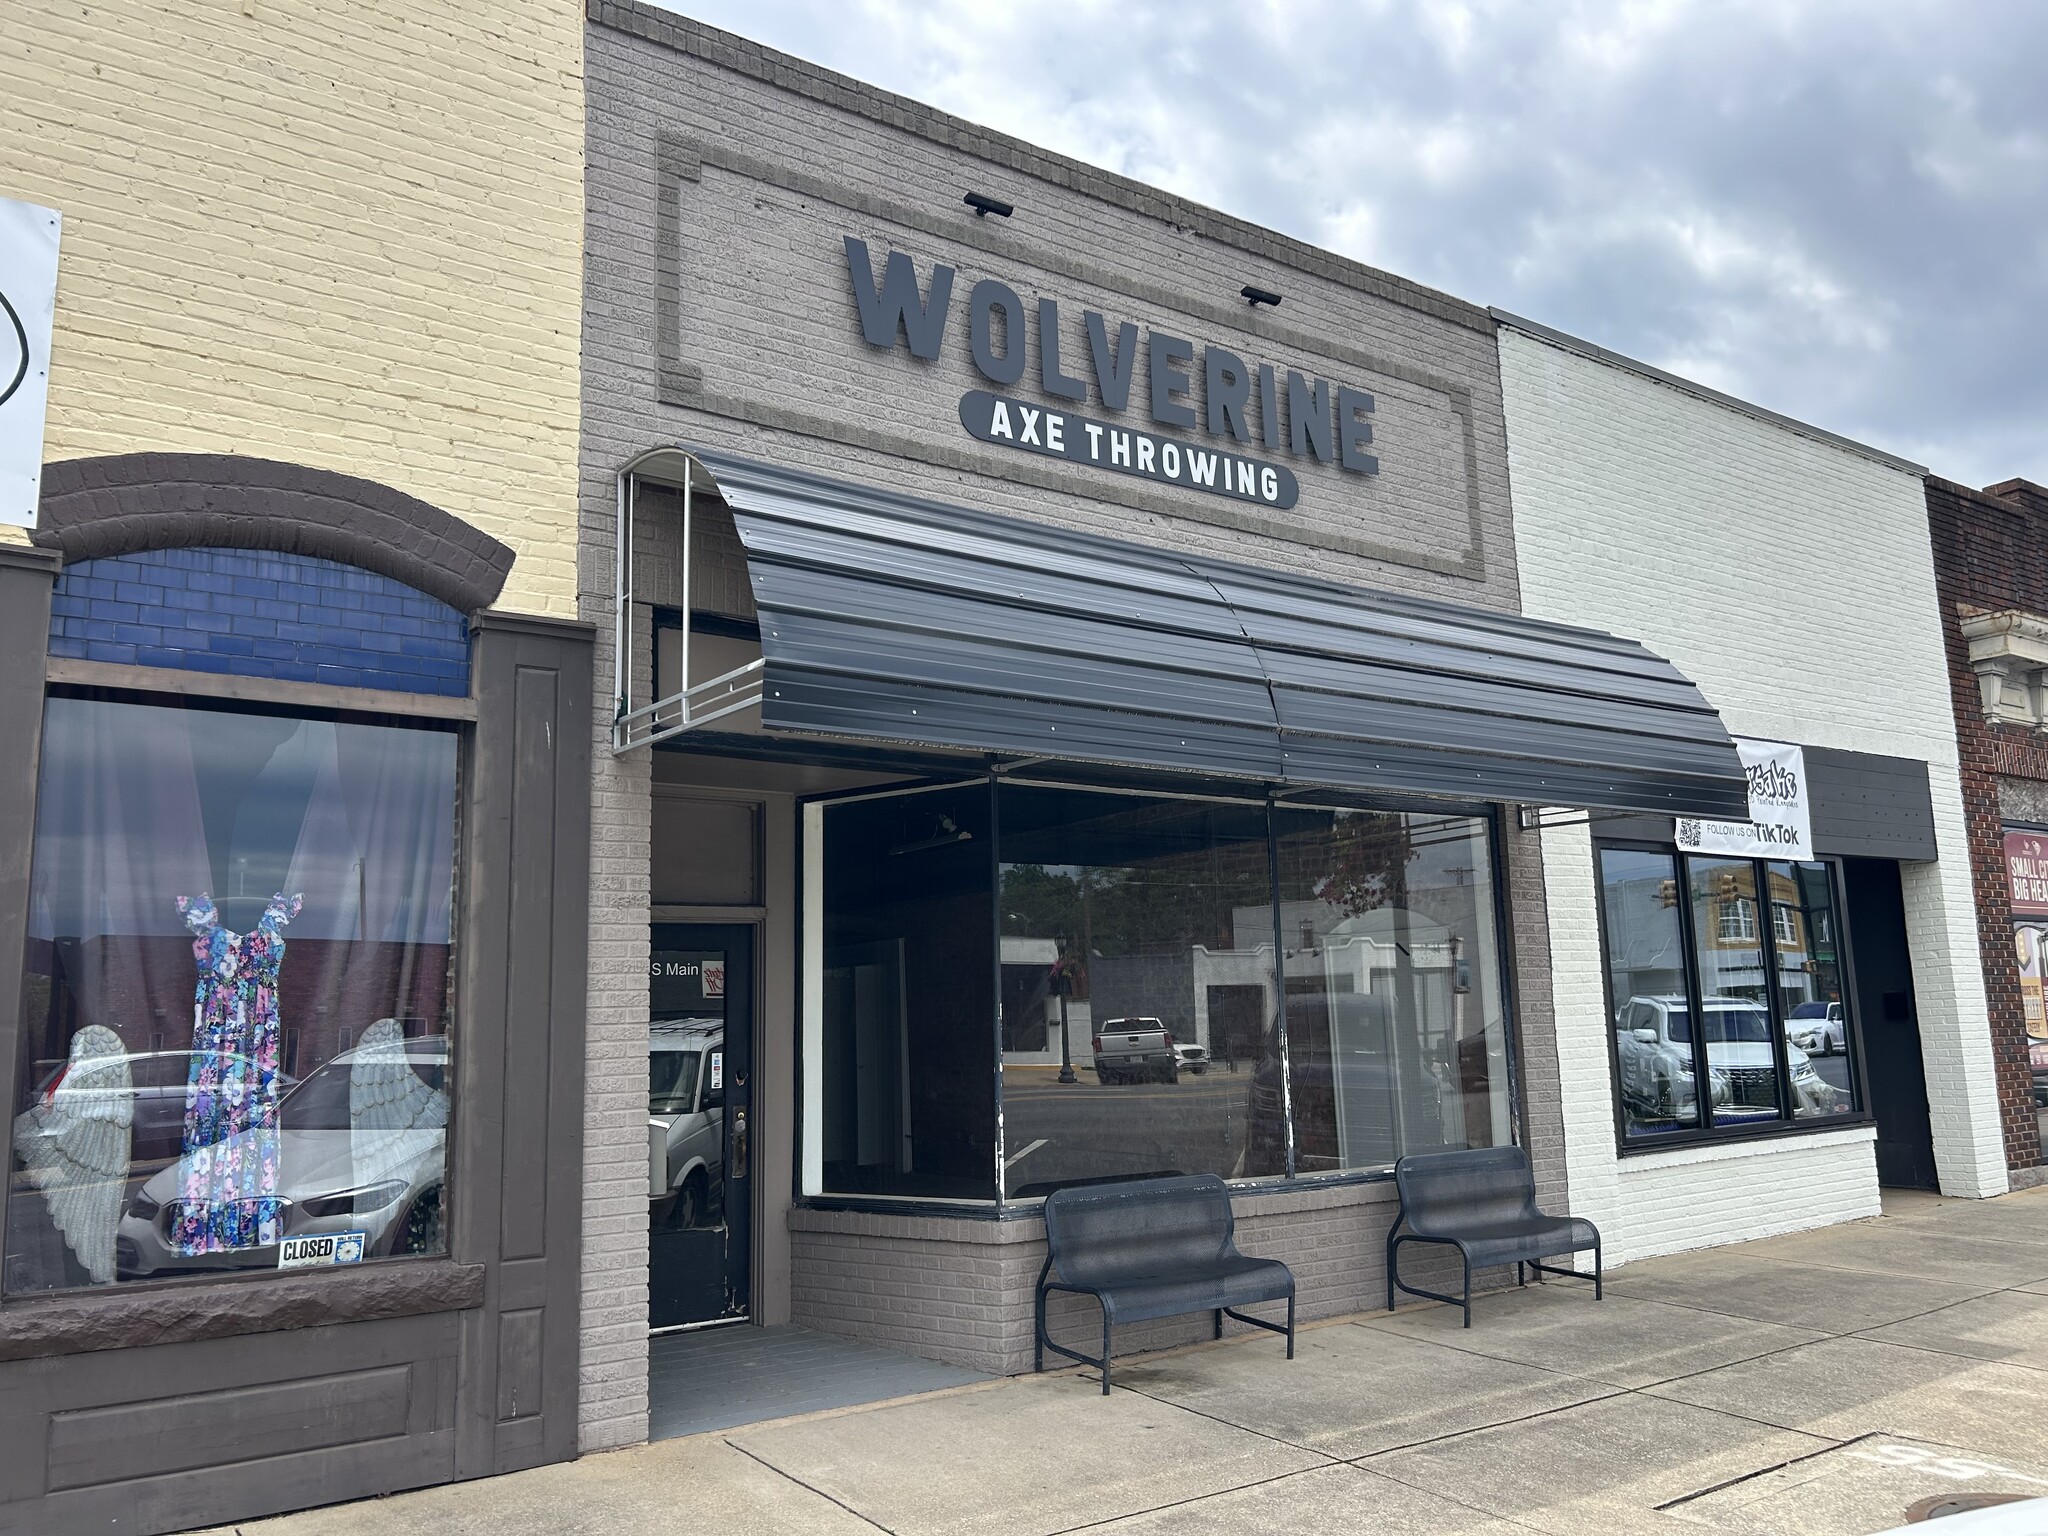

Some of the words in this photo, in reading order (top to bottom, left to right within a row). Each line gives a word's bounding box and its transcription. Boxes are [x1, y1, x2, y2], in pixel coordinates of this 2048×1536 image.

[843, 235, 1379, 475] WOLVERINE
[990, 401, 1065, 452] AXE
[1085, 423, 1278, 501] THROWING
[1707, 824, 1735, 836] FOLLOW
[1736, 827, 1745, 837] US
[1746, 828, 1756, 838] ON
[1754, 822, 1799, 845] TikTok
[2010, 856, 2039, 879] SMALL
[2012, 877, 2030, 901] BIG
[2030, 879, 2048, 902] HEA
[651, 963, 662, 976] S
[666, 963, 699, 976] Main
[283, 1238, 333, 1261] CLOSED
